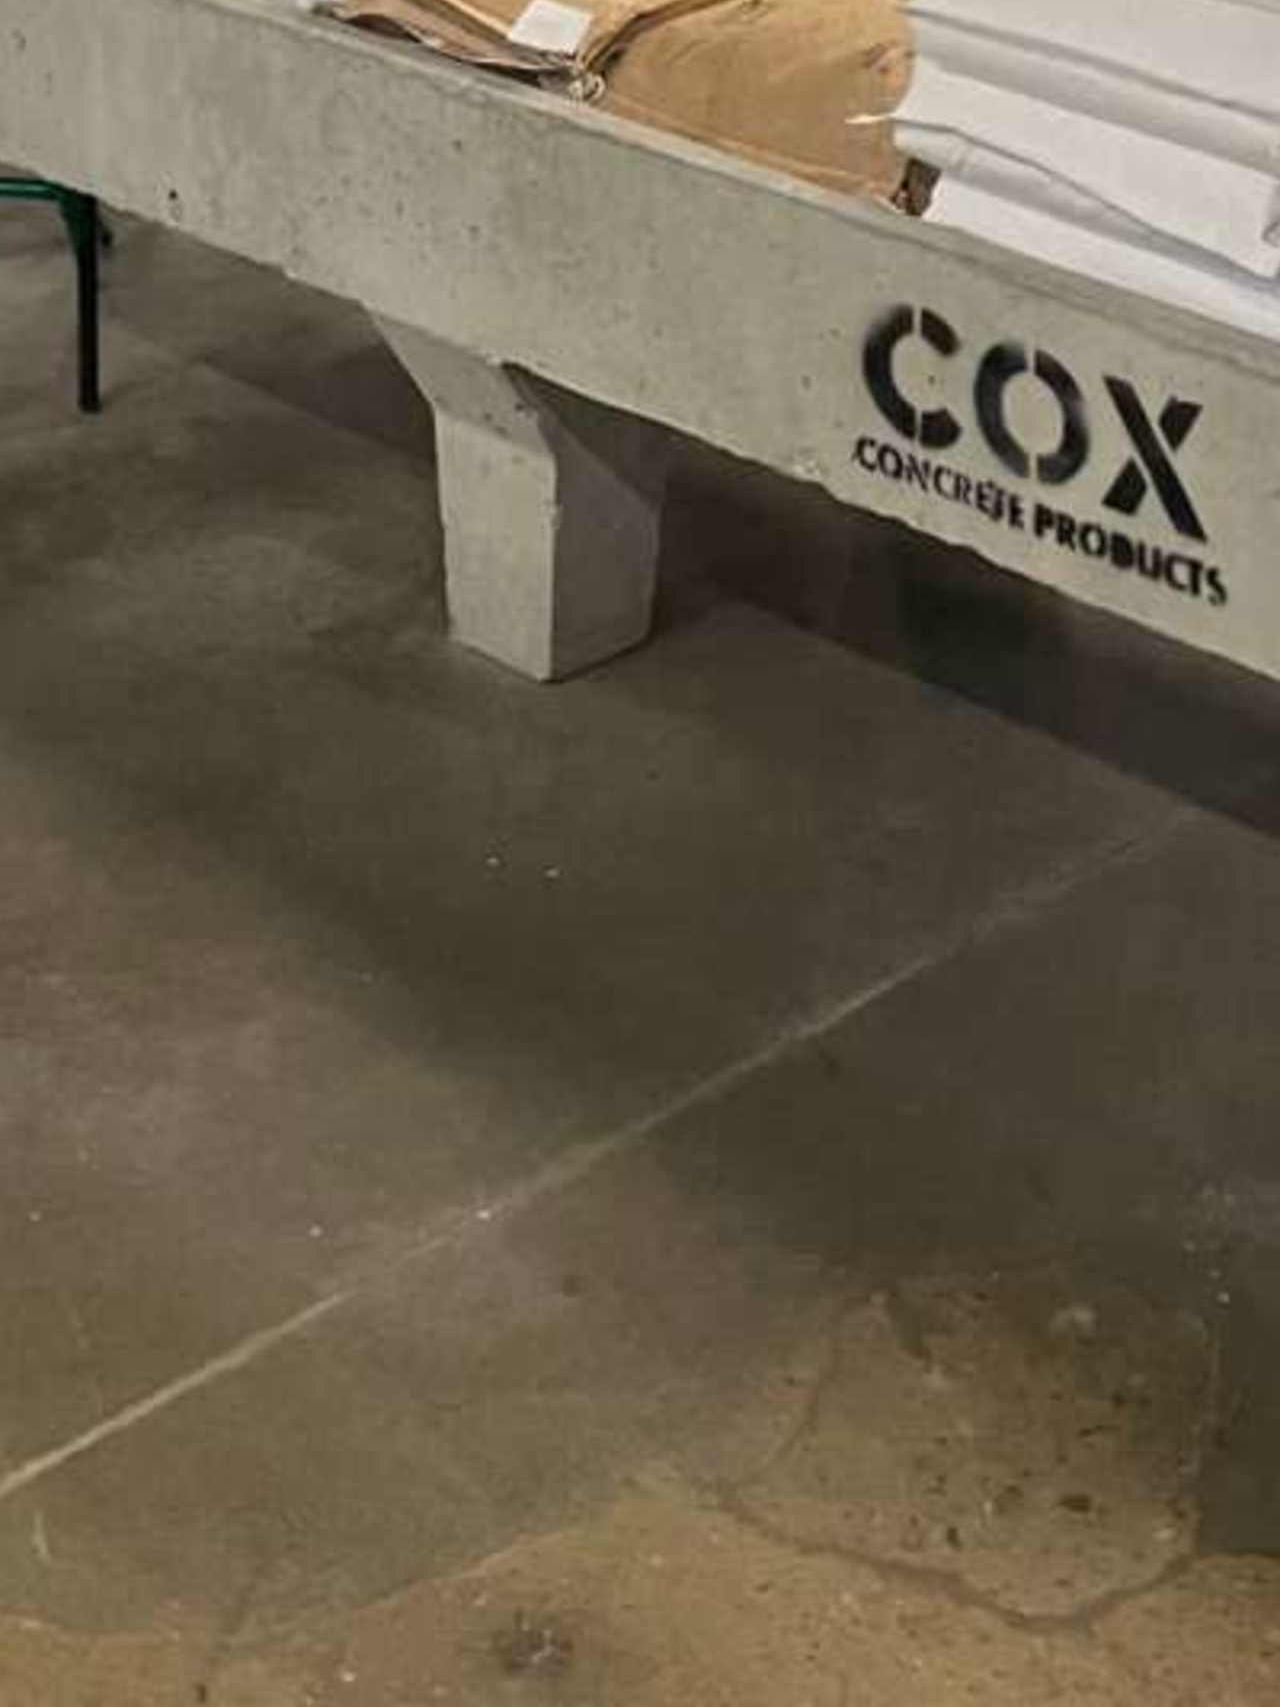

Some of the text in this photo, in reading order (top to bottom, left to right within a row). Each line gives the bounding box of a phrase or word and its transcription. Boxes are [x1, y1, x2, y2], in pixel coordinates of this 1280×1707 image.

[854, 434, 1230, 607] CONCRETE PRODUCTS
[860, 302, 1208, 543] COX
